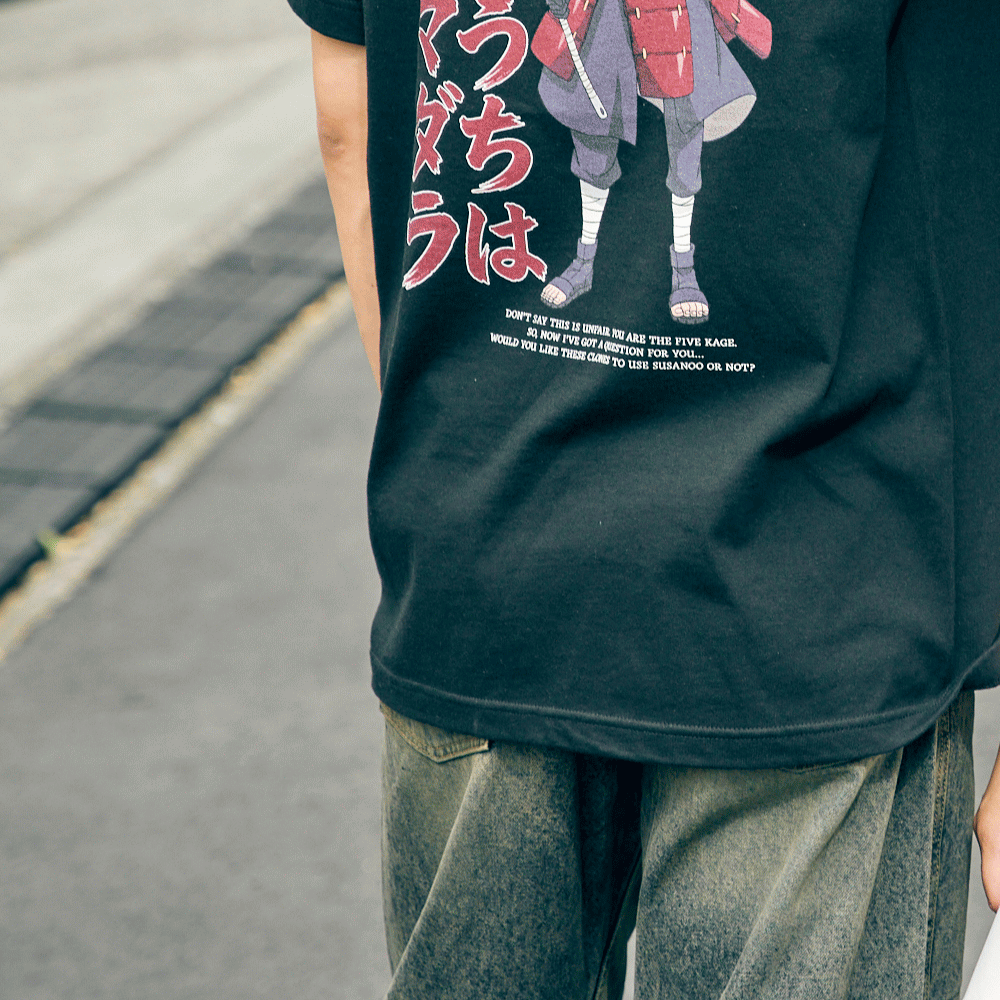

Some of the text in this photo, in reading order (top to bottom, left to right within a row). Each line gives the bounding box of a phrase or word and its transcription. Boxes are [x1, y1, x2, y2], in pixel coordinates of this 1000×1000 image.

[505, 308, 532, 323] DON'T
[532, 314, 548, 326] SAY
[549, 317, 570, 331] THIS
[571, 321, 581, 332] IS
[611, 327, 625, 341] YOU
[625, 331, 646, 345] ARE
[649, 335, 672, 346] THE
[675, 336, 702, 347] FIVE
[704, 338, 738, 348] KAGE.
[526, 326, 705, 359] SO, NOW I'VE GOT A QUESTION FOR YOU...
[490, 332, 756, 373] WOULD YOU LIKE THESE CLONES TO USE SUSANOO OR NOT?
